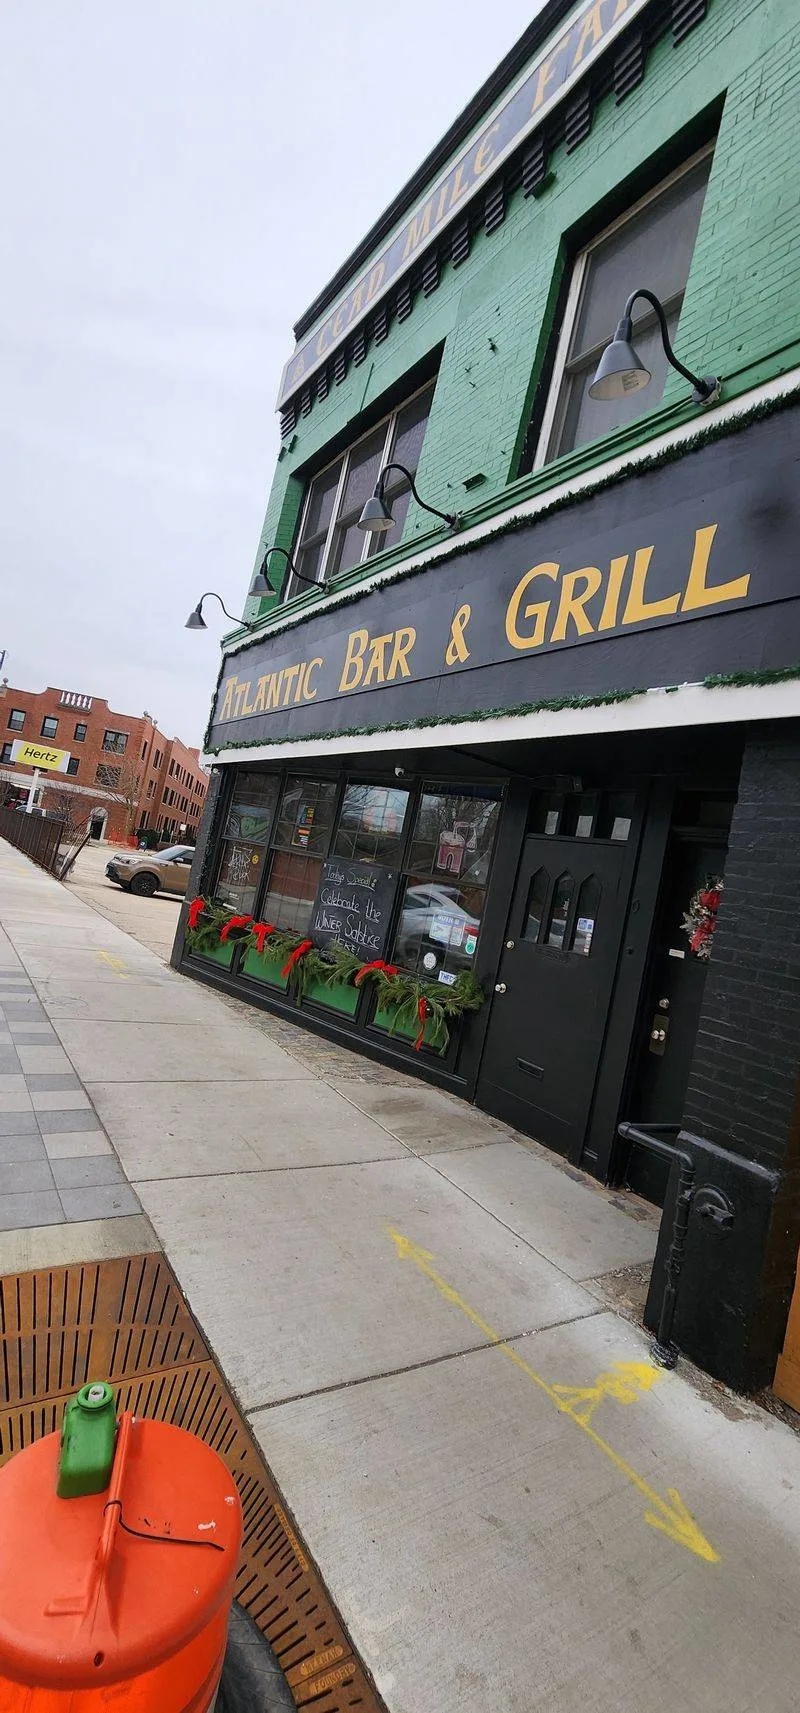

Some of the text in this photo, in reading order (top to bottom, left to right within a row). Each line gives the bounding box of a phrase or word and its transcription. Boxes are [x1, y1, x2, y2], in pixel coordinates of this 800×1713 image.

[403, 123, 500, 260] MILE
[219, 523, 751, 721] ATLANTIC BAR & GRILL
[24, 747, 58, 762] Hertz
[321, 887, 381, 922] Celebrate the
